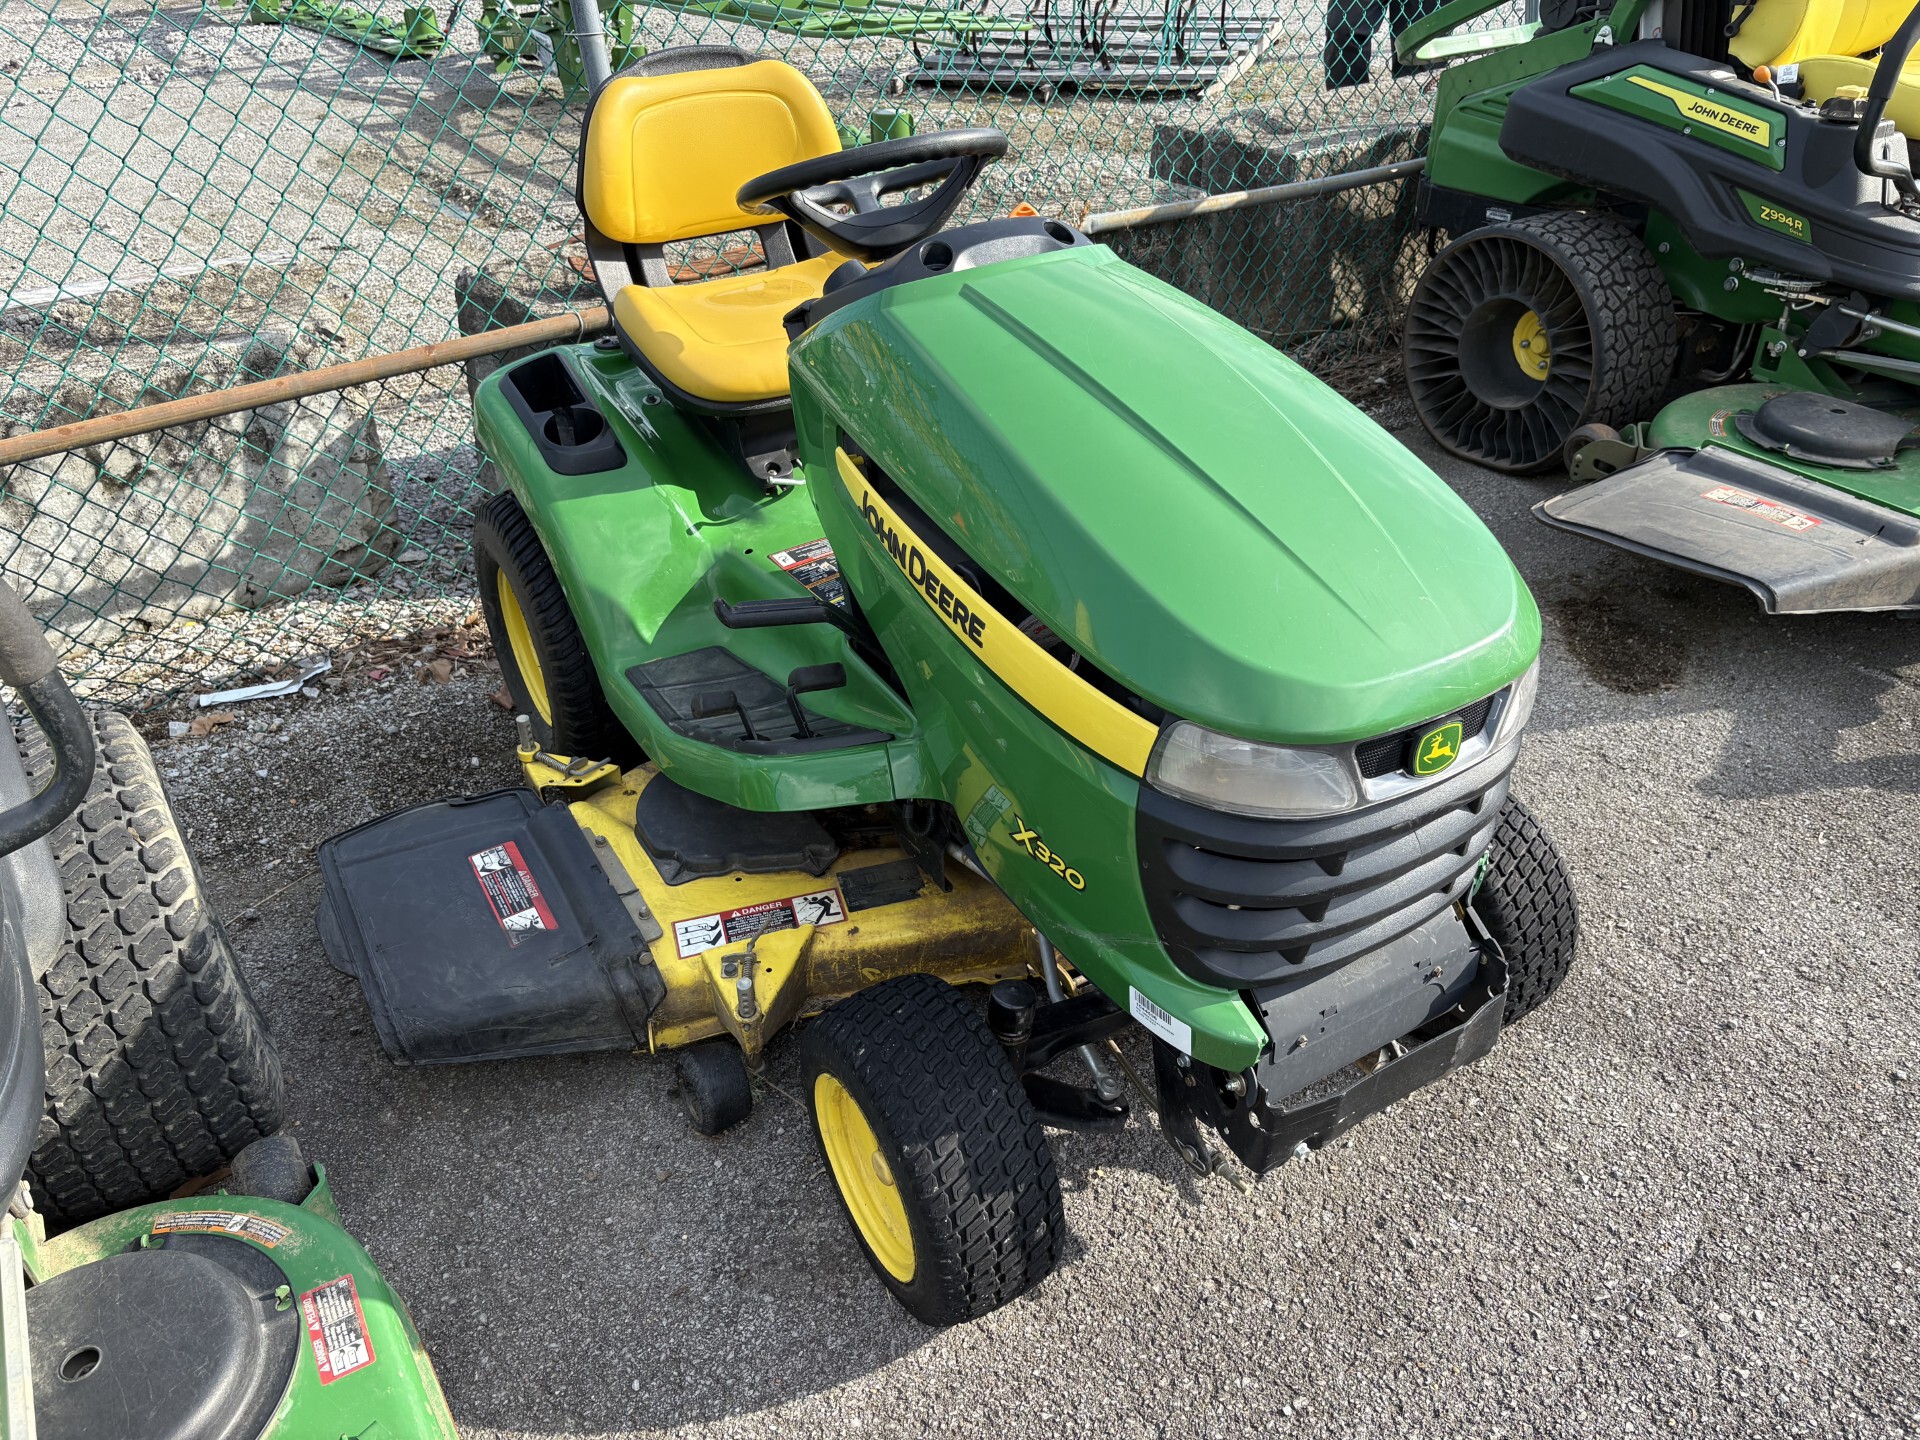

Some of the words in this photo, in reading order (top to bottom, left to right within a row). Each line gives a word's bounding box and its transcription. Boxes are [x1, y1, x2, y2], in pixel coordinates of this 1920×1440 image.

[1688, 102, 1720, 120] JOHN
[1719, 113, 1760, 135] DEERE
[1760, 206, 1803, 231] Z994R
[858, 490, 907, 570] JOHN
[908, 545, 986, 649] DEERE
[1009, 813, 1086, 891] X320
[521, 874, 539, 899] DANGER
[742, 901, 783, 915] DANGER
[303, 1297, 316, 1325] PELIGRO
[313, 1337, 327, 1366] DANGER
